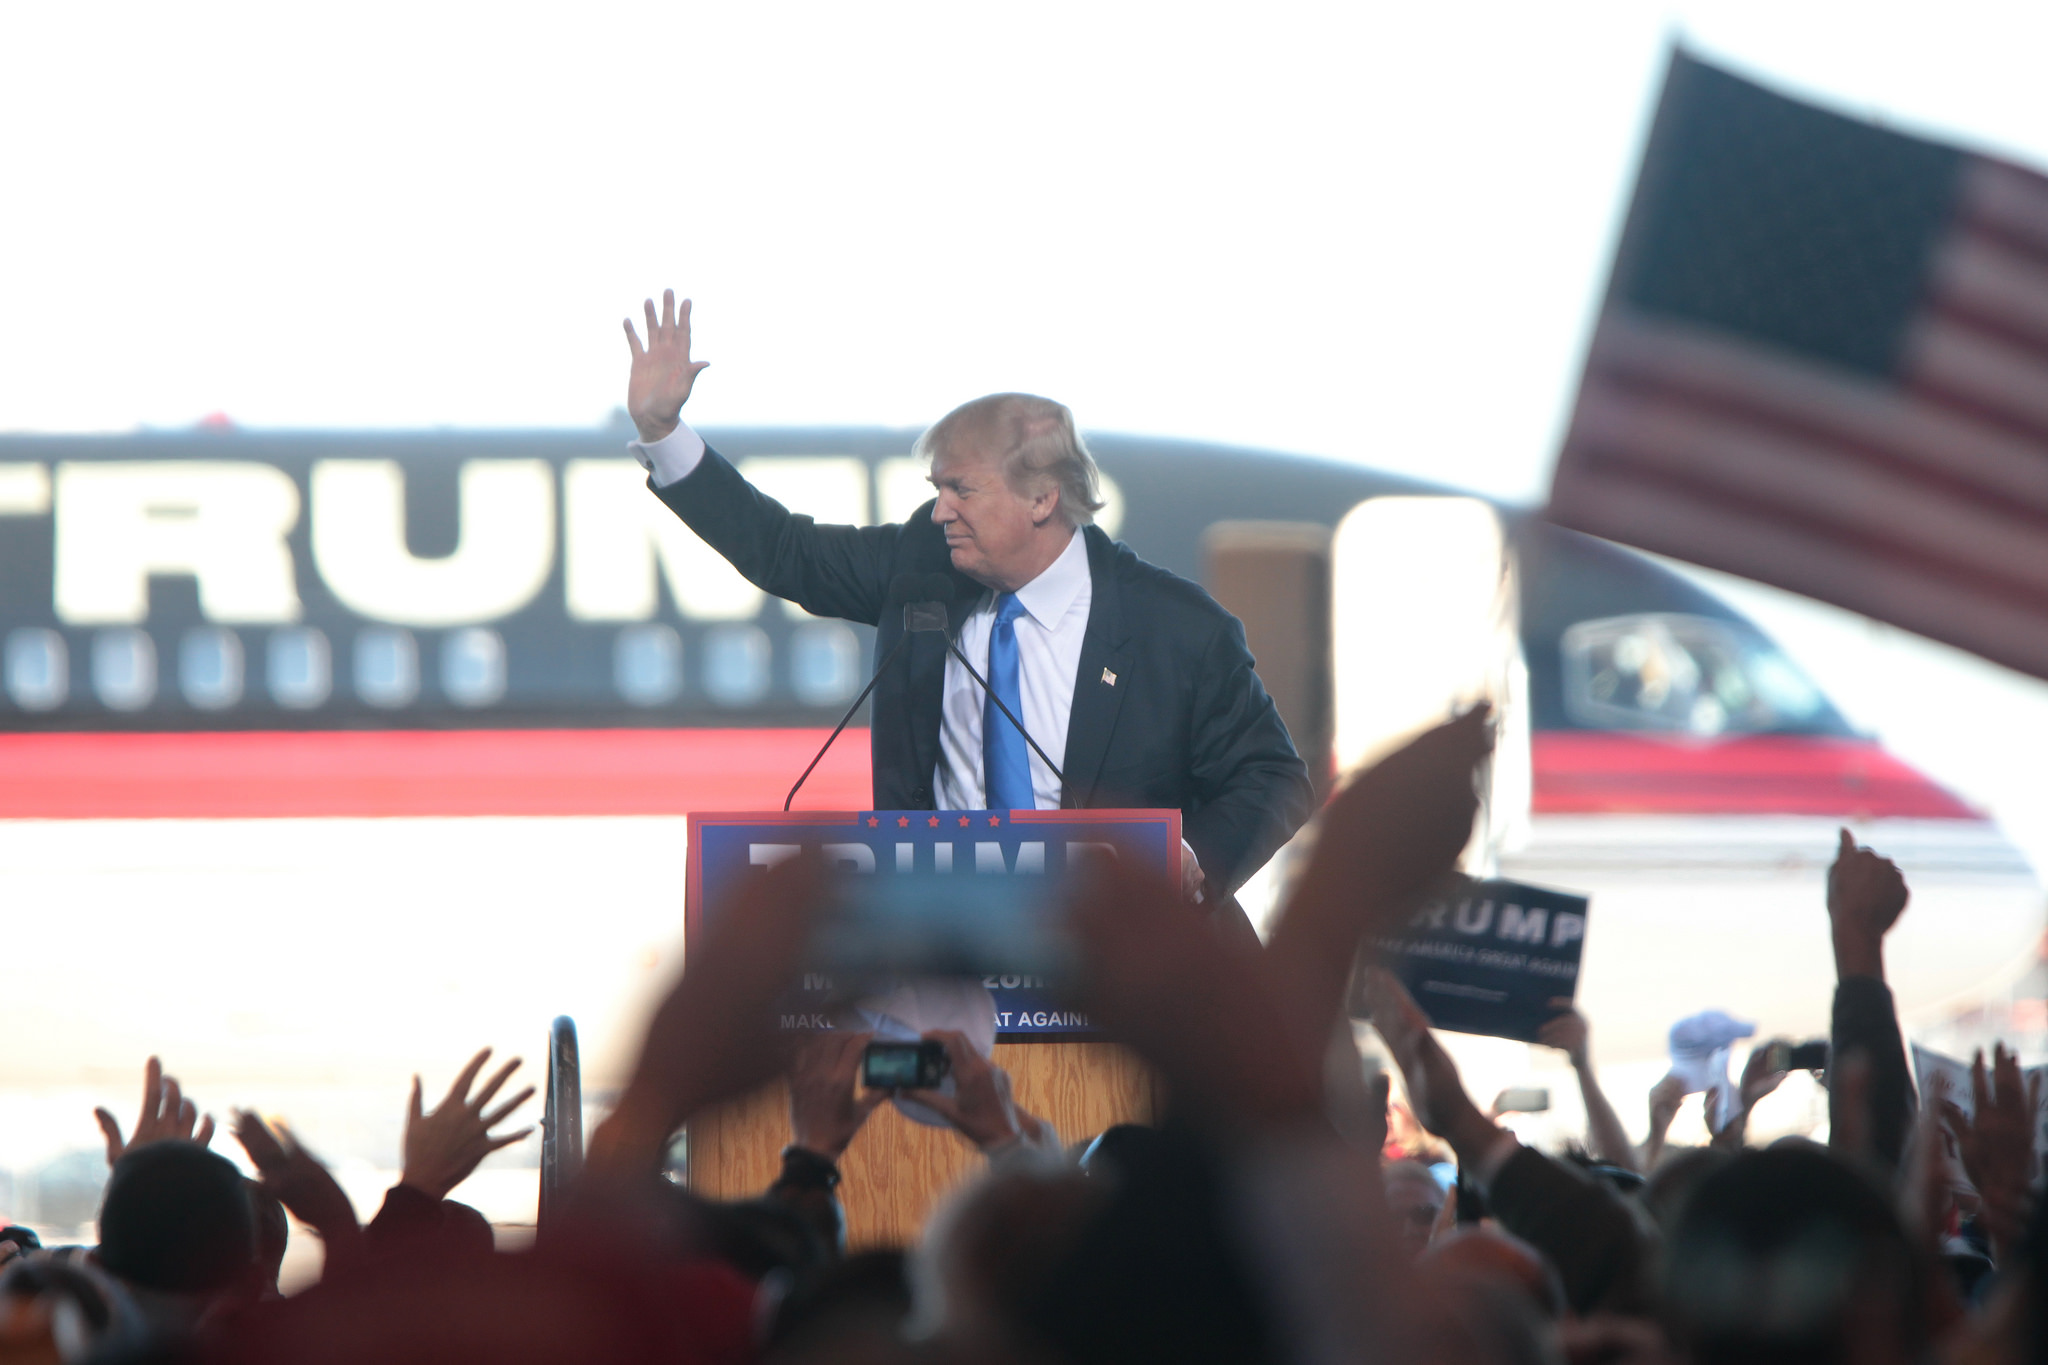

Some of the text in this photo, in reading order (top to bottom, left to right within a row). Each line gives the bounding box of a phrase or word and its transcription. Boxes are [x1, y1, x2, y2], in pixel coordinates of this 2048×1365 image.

[0, 455, 1124, 629] RUM
[1408, 897, 1584, 948] RUMP
[780, 1013, 834, 1029] MAK
[1018, 1011, 1088, 1027] AGAIN!
